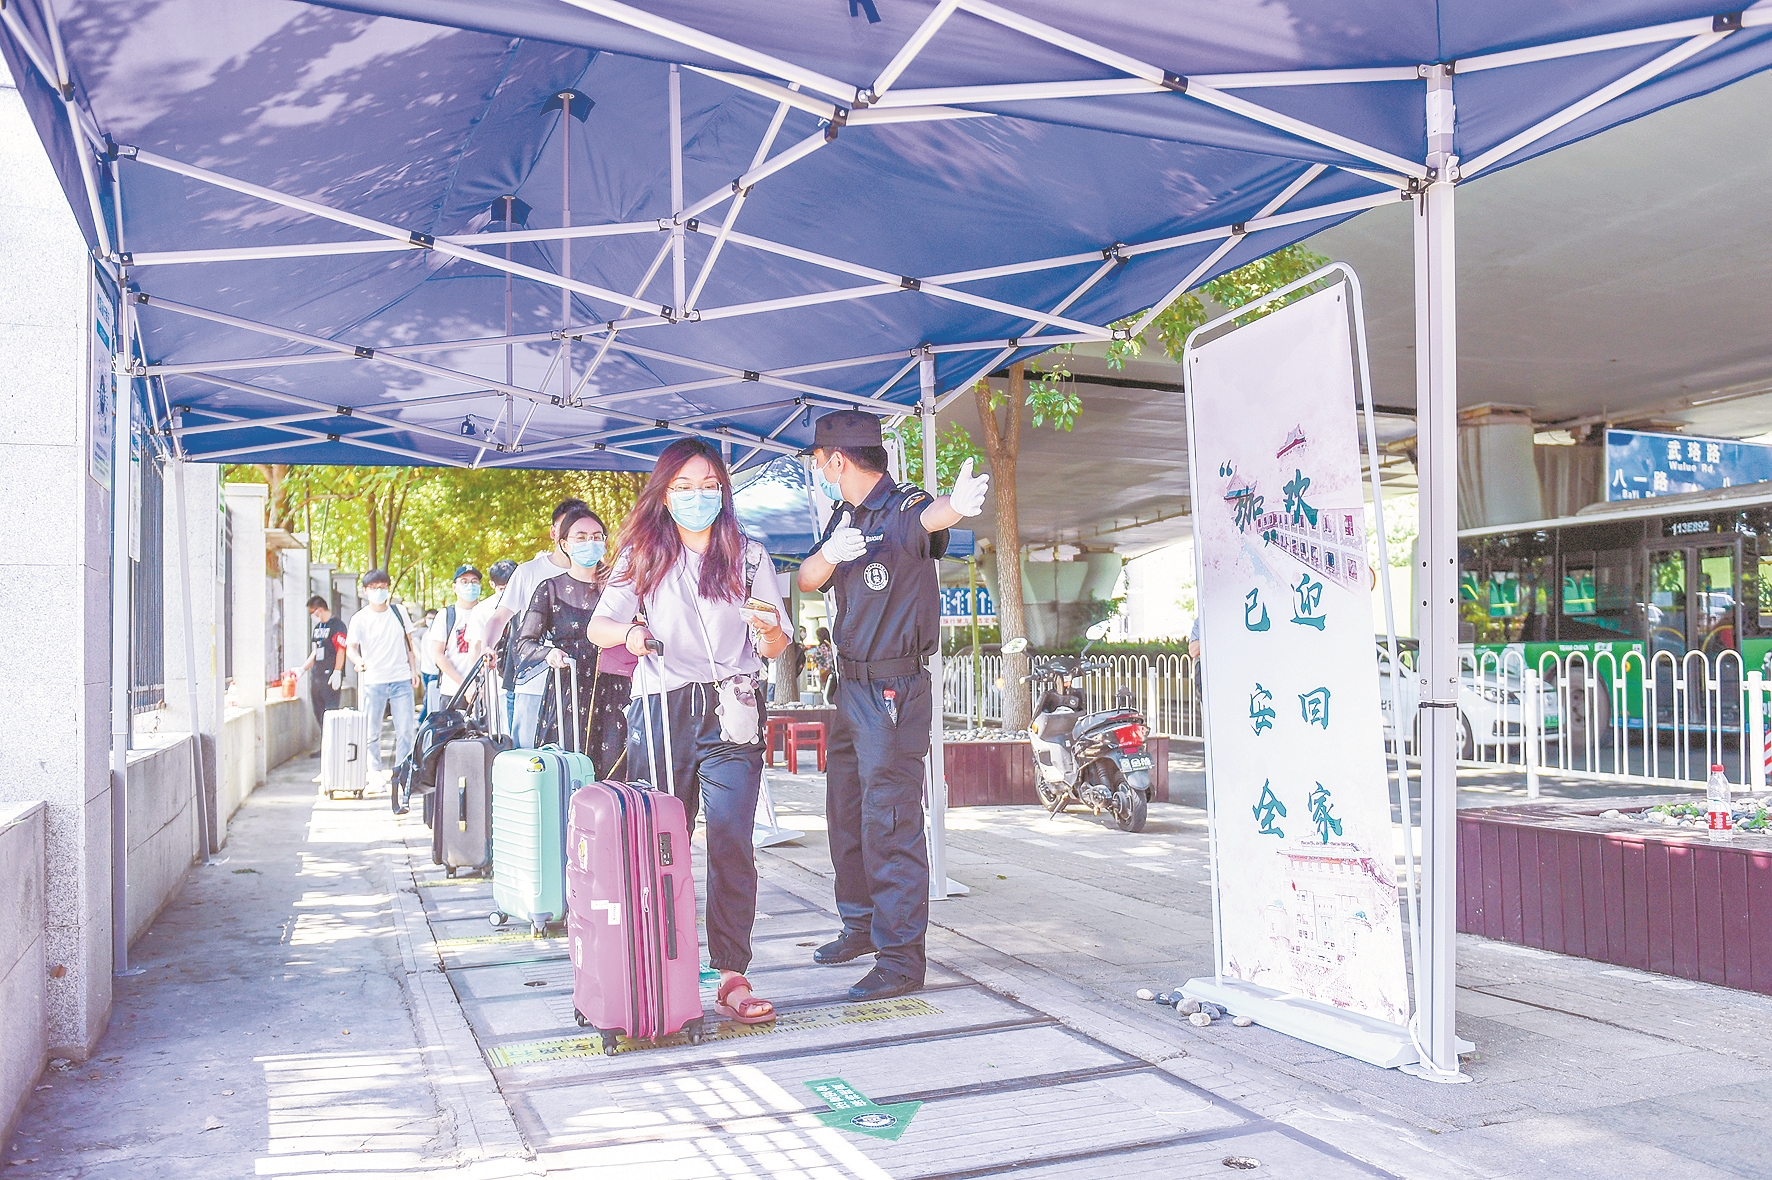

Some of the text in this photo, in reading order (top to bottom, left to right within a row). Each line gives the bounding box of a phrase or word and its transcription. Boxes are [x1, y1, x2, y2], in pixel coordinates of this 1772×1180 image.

[1667, 440, 1720, 464] 武珞路
[1669, 461, 1716, 474] Wuluo Rd.
[1612, 469, 1668, 491] 八一路
